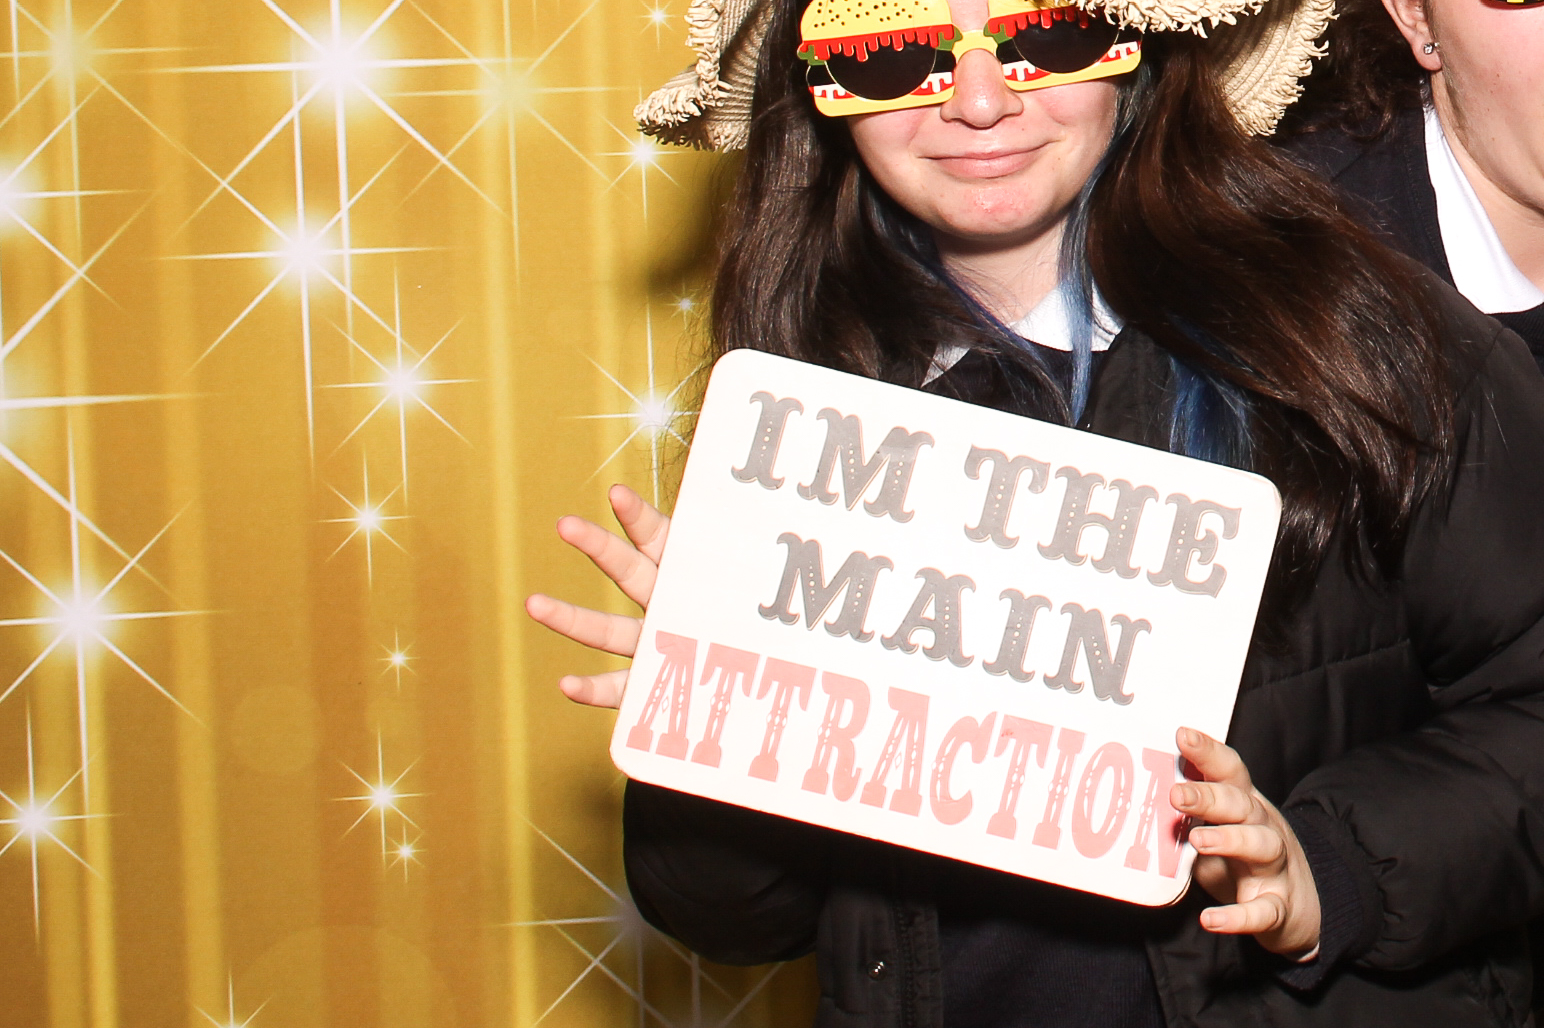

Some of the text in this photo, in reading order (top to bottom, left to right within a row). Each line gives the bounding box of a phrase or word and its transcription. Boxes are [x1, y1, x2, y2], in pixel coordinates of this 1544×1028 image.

[730, 390, 1242, 599] IM THE
[757, 531, 1152, 706] MAIN
[625, 629, 1204, 879] ATTRACTION
